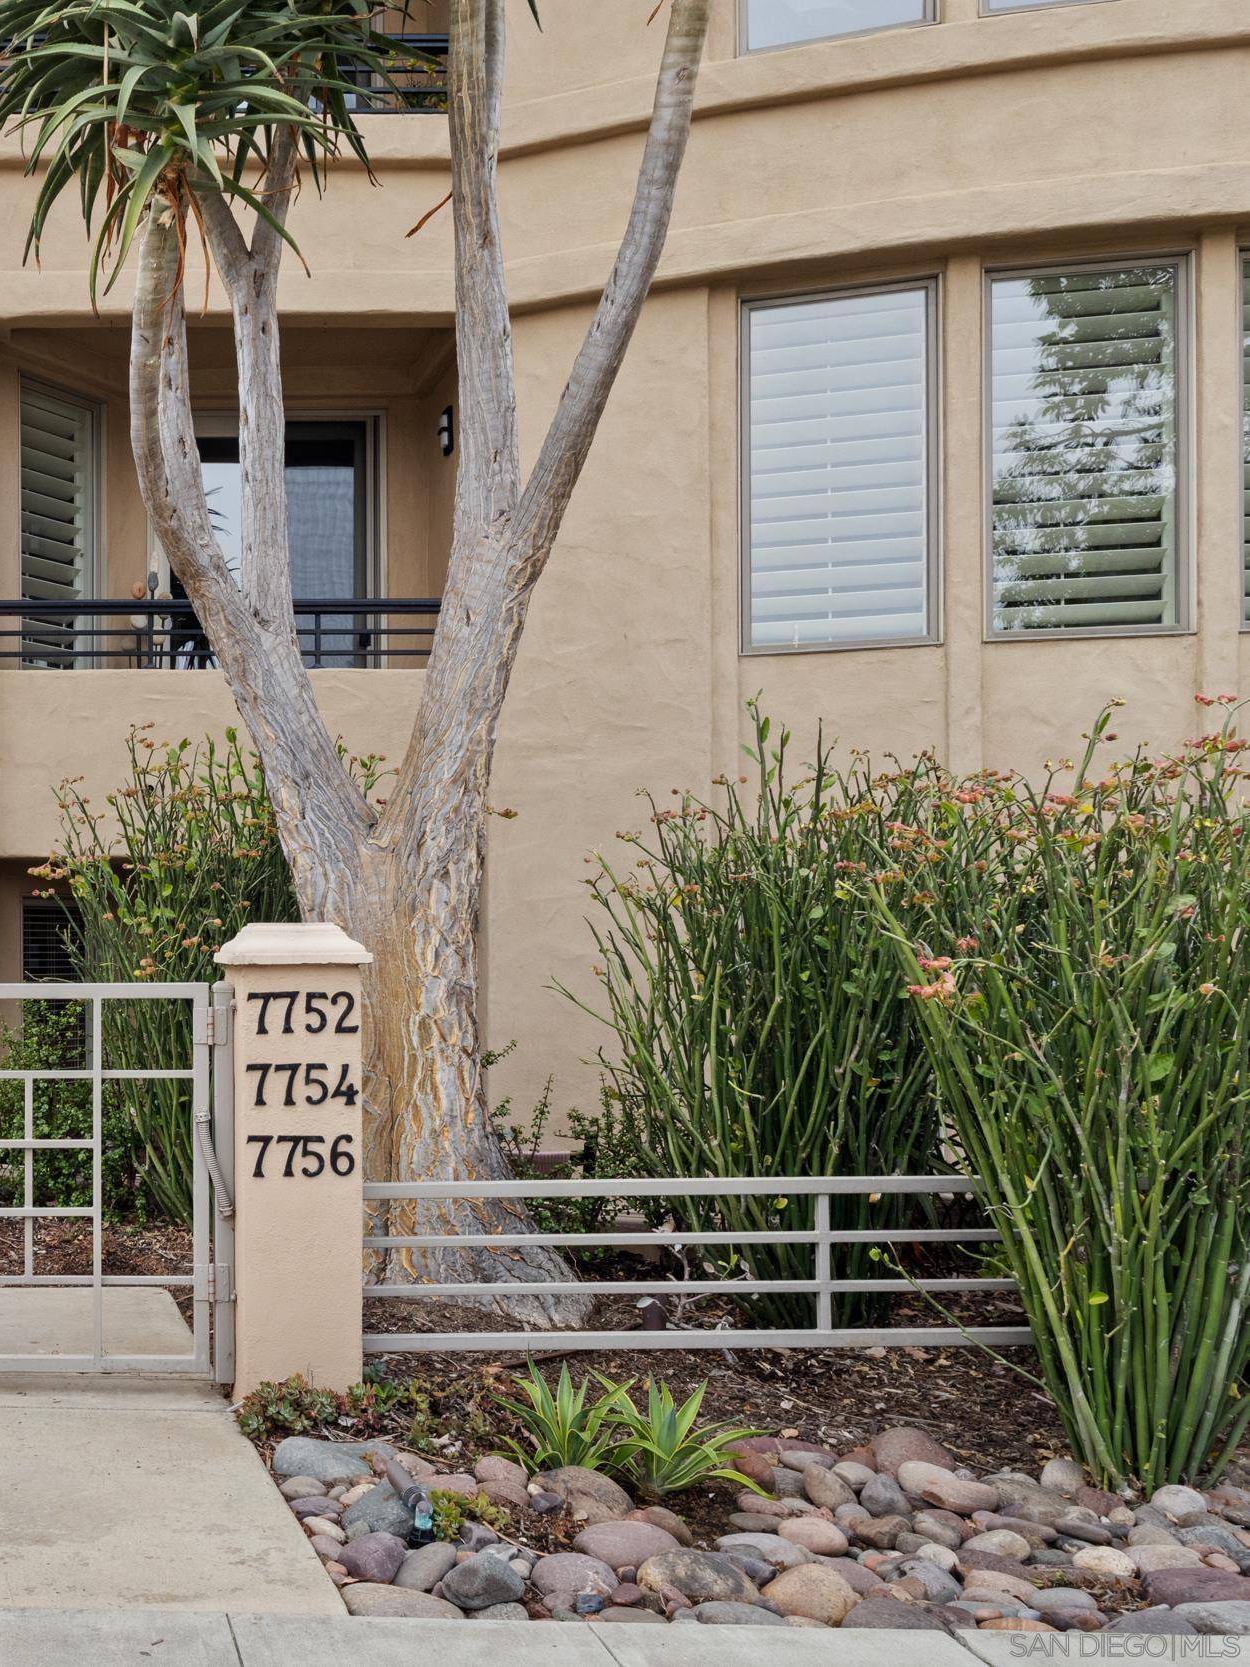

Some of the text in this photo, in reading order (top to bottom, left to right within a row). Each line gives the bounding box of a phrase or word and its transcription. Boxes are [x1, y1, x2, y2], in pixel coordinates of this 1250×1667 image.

[246, 990, 360, 1035] 7752
[245, 1062, 360, 1107] 7754
[246, 1134, 355, 1178] 7756
